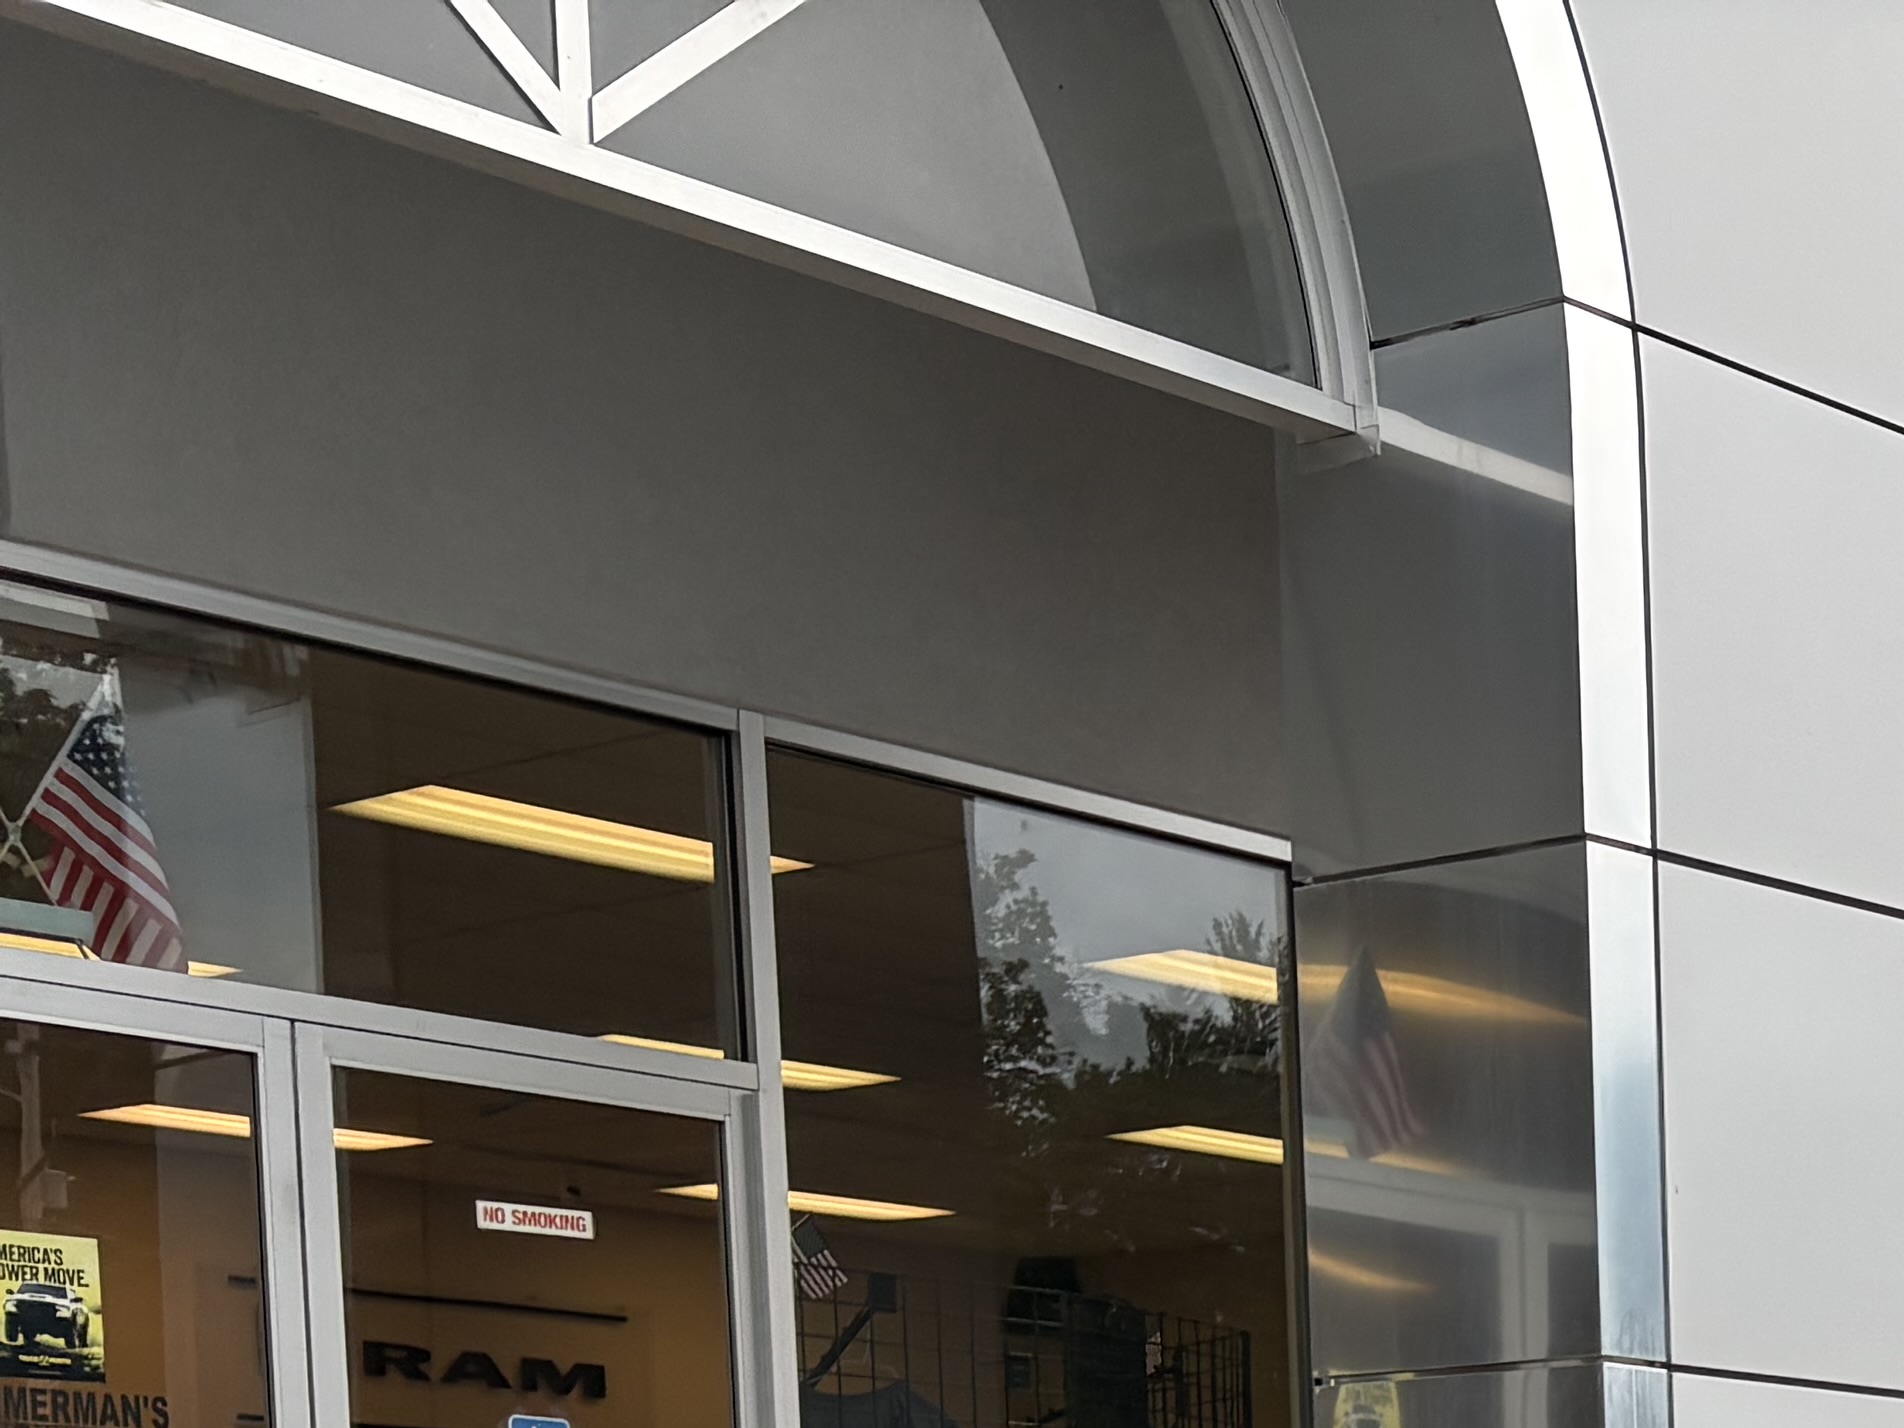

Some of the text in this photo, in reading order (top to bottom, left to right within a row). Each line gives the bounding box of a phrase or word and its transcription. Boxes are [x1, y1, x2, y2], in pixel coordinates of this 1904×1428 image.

[483, 1205, 587, 1233] NO SMOKING
[362, 1339, 607, 1400] RAM
